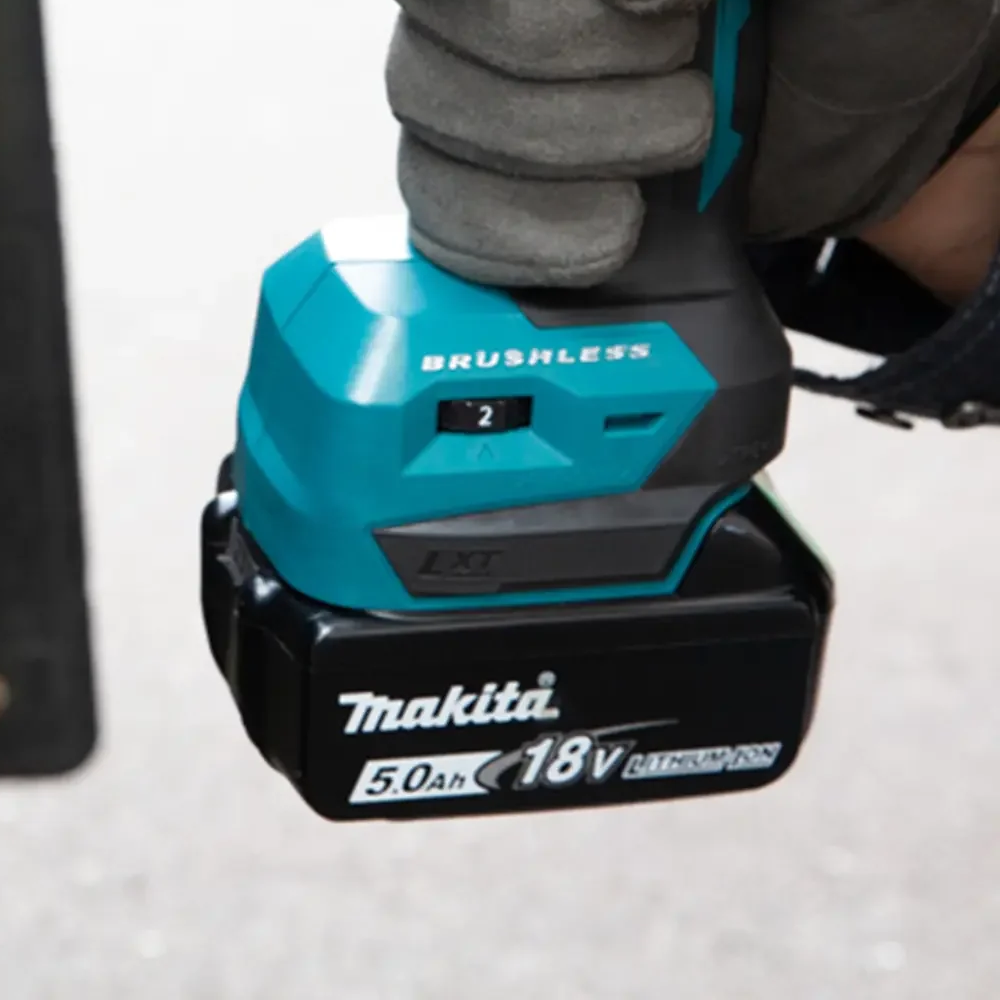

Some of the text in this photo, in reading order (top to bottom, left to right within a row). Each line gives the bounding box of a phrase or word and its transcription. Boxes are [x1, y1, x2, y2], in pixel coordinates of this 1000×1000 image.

[420, 342, 652, 372] BRUSHLESS
[478, 405, 494, 427] 2
[417, 549, 503, 577] LXT
